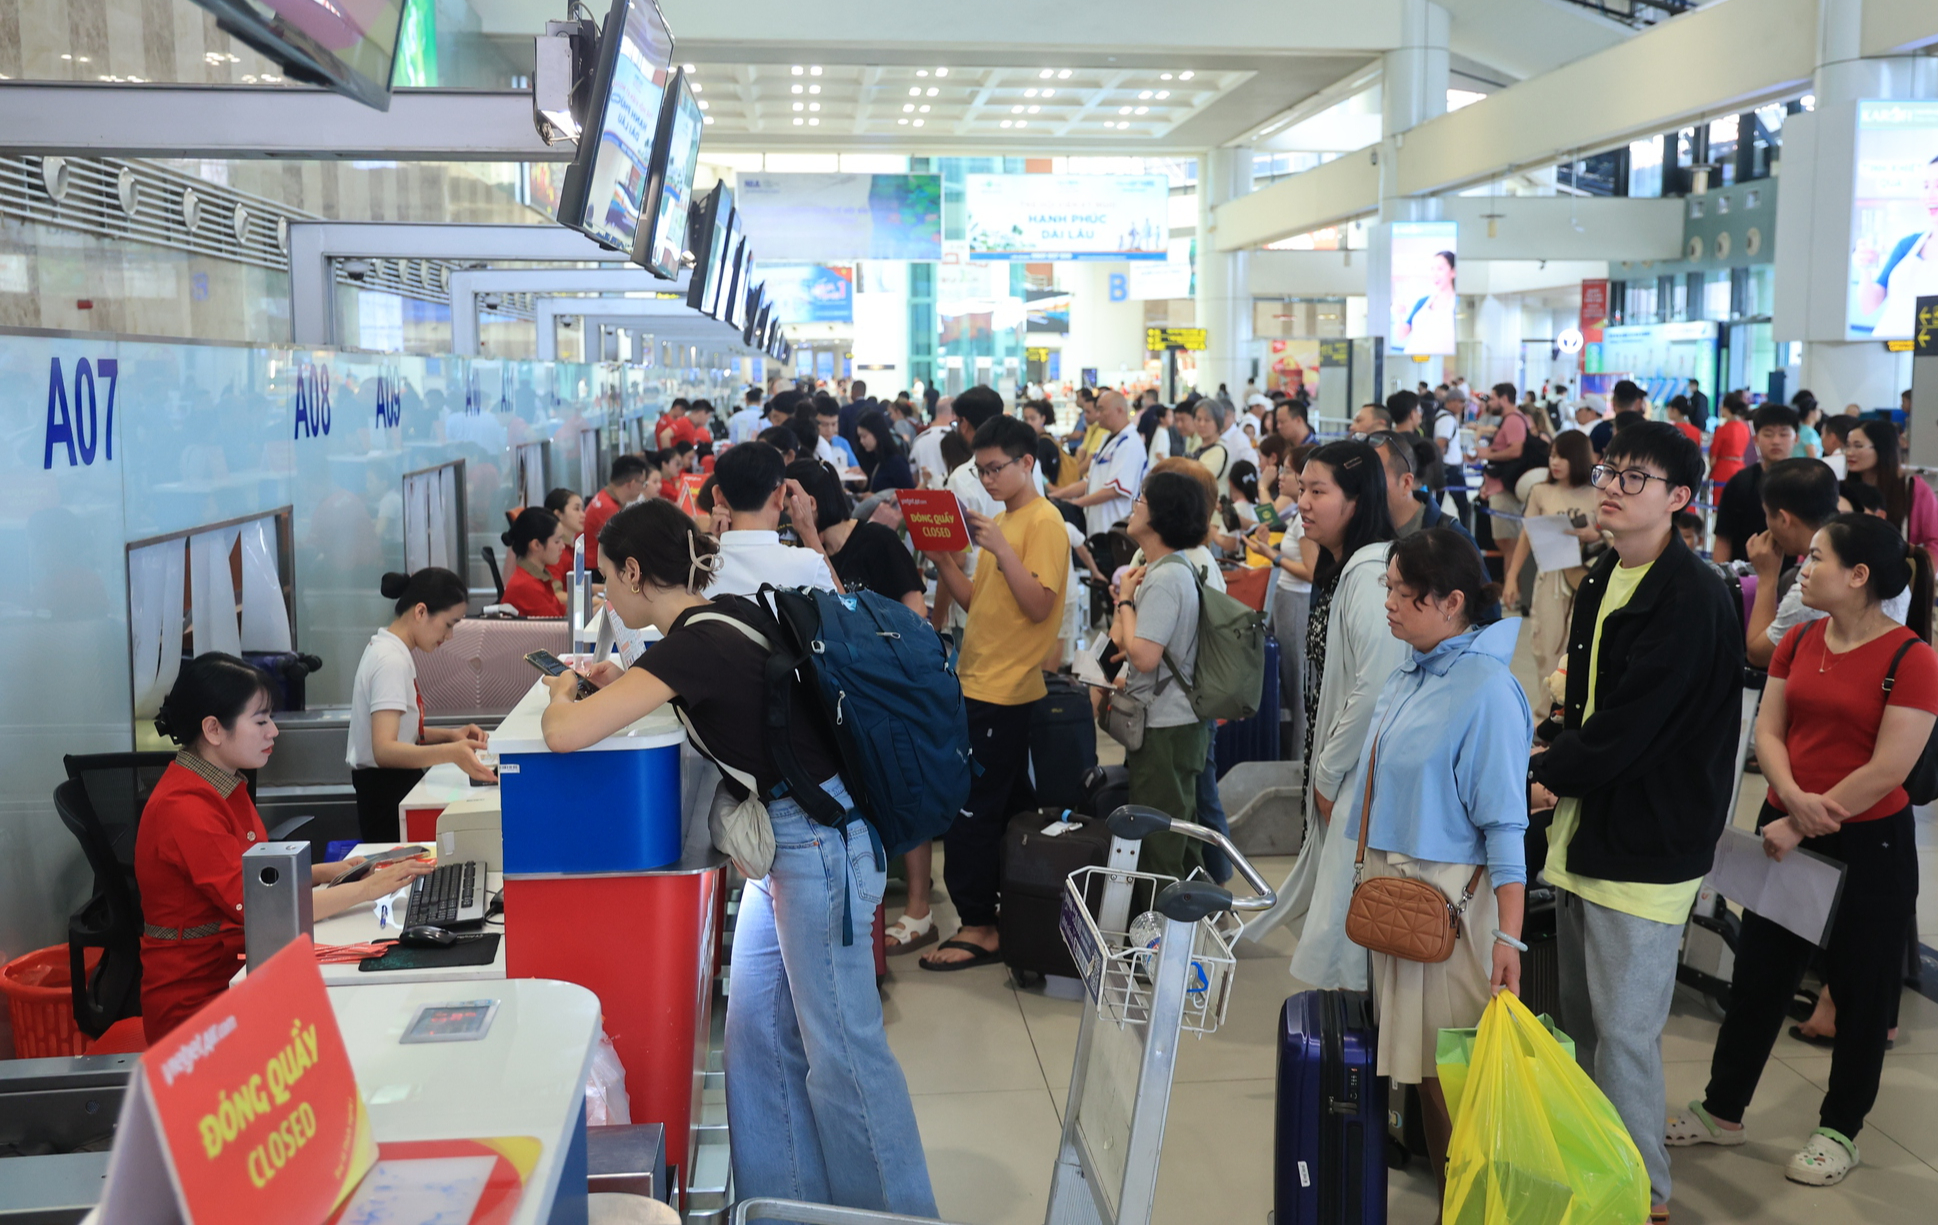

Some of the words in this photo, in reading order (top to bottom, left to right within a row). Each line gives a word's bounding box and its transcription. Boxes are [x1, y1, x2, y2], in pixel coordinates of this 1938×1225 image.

[1109, 272, 1128, 303] B
[44, 357, 118, 469] A07
[295, 363, 331, 440] A08
[376, 364, 401, 429] A09
[922, 526, 951, 538] CLOSED
[199, 1074, 271, 1160] ĐÓNG
[267, 1018, 319, 1105] QUẦY
[248, 1102, 317, 1188] CLOSED
